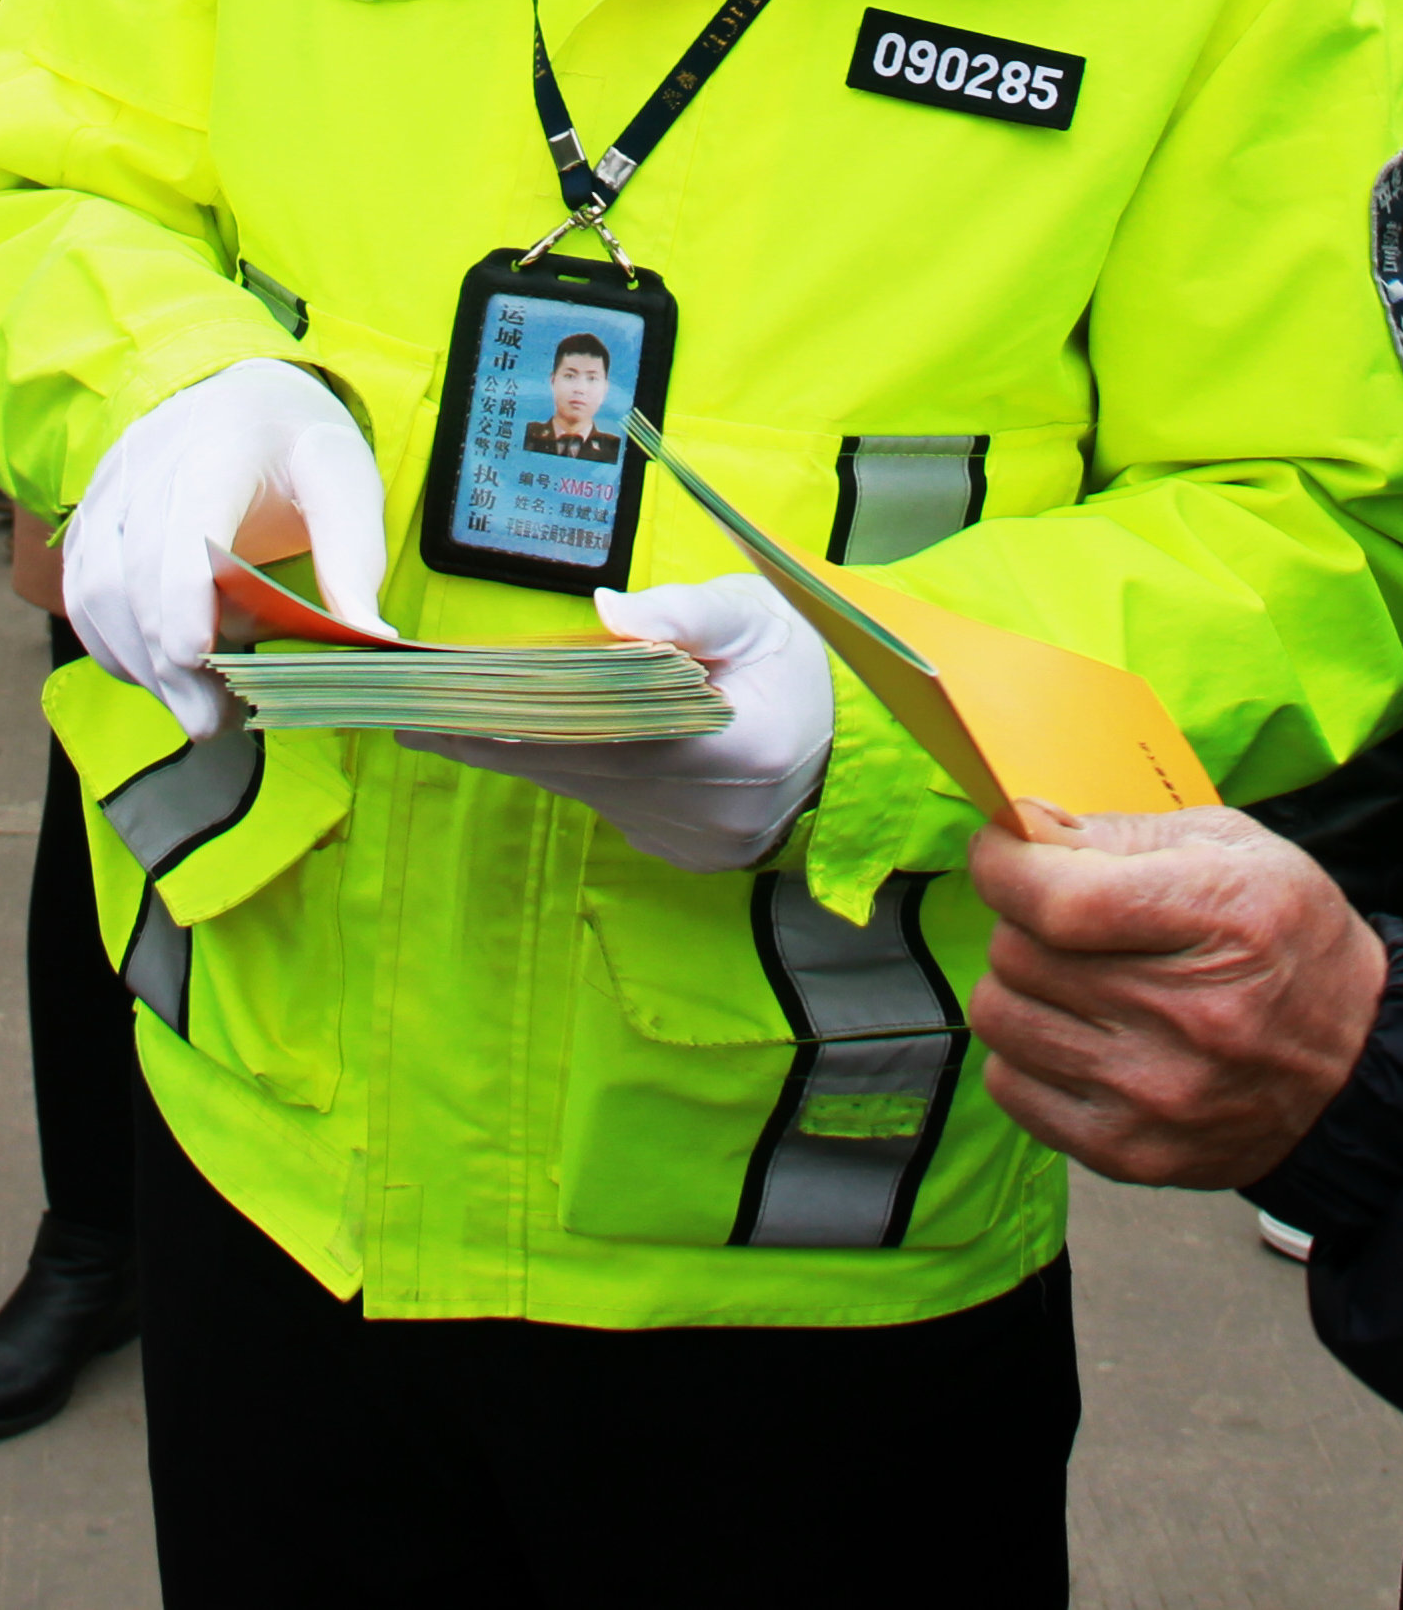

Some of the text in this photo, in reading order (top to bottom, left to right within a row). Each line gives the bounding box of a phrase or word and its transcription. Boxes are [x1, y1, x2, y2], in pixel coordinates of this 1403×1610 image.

[872, 31, 1065, 111] 090285
[493, 303, 526, 372] 运城市
[468, 463, 499, 534] 执勤证
